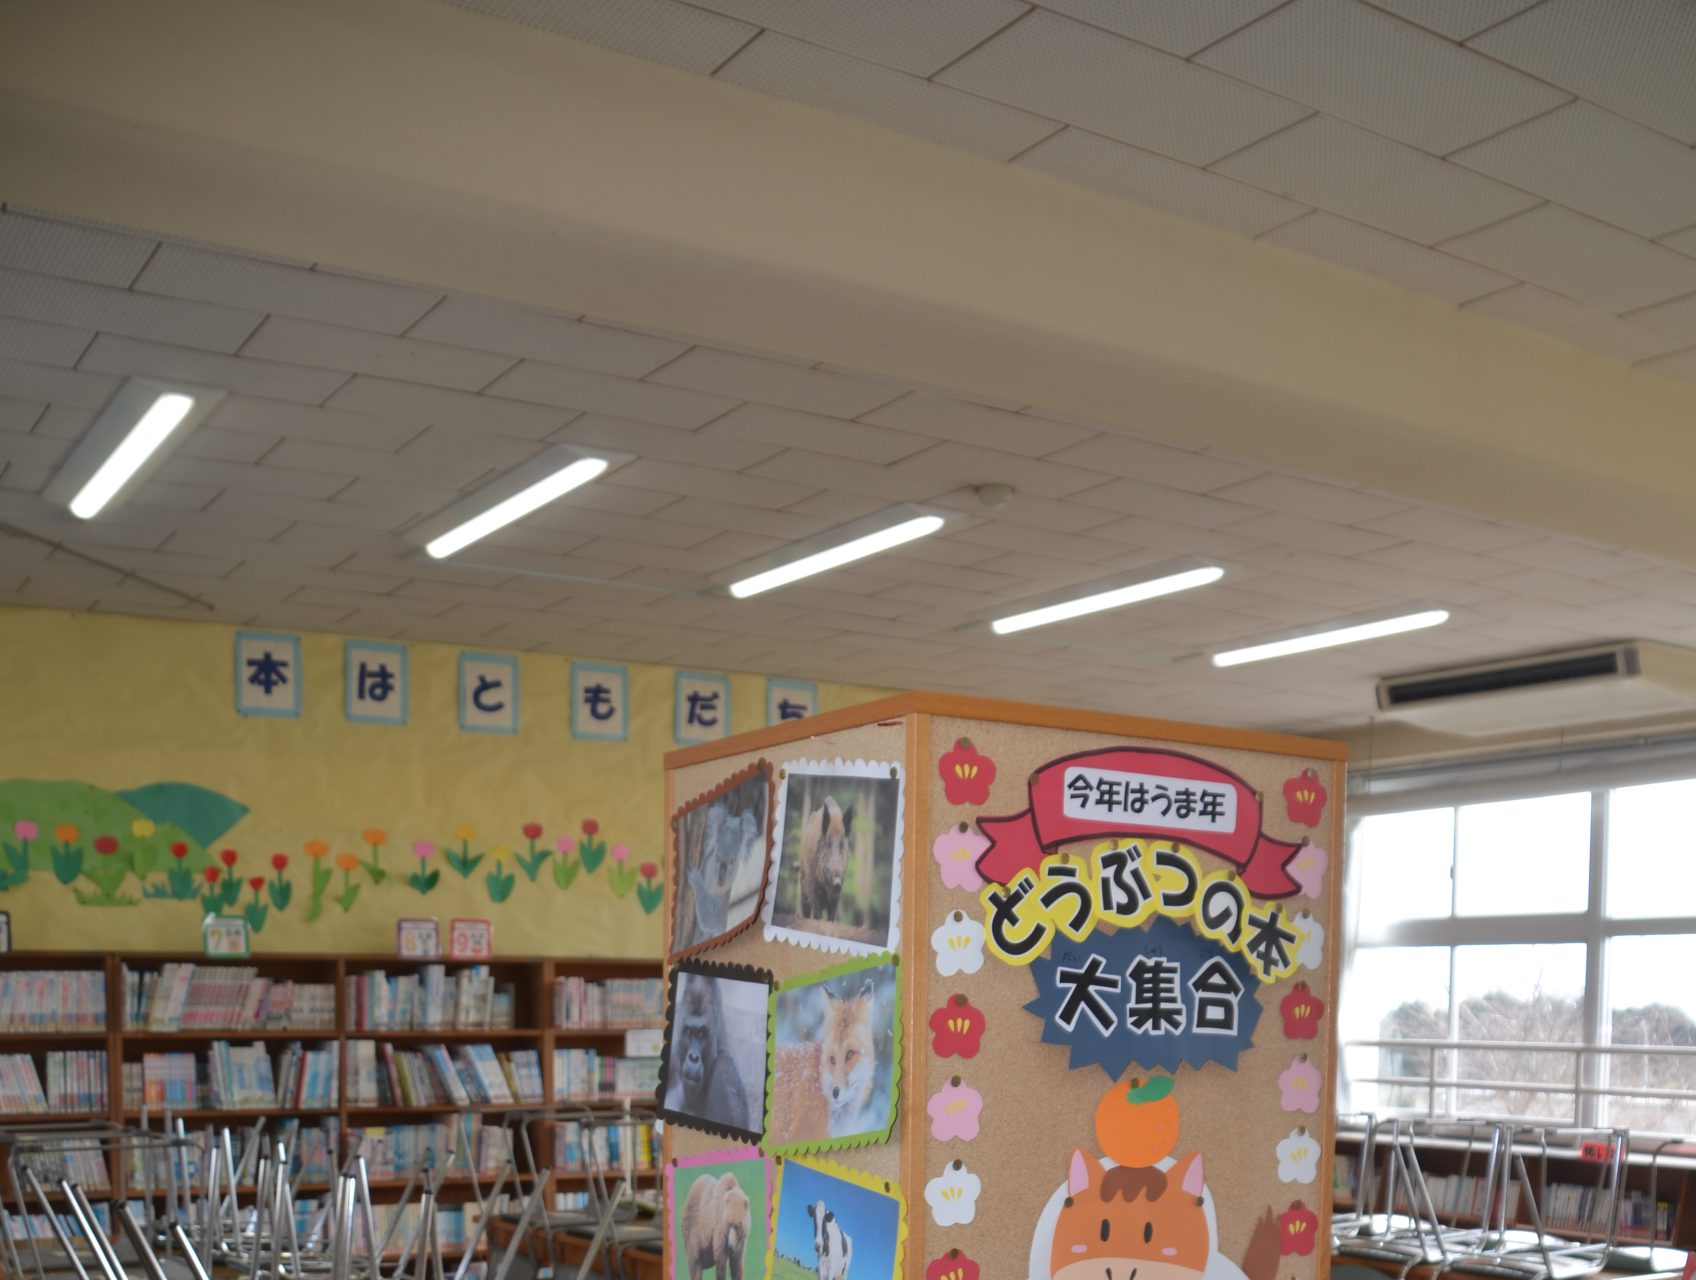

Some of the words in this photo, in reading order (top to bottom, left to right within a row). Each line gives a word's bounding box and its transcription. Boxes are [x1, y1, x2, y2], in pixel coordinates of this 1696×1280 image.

[1067, 772, 1227, 824] 今年はうま年
[986, 844, 1298, 977] どうぶつの本
[1056, 954, 1244, 1037] 大集合
